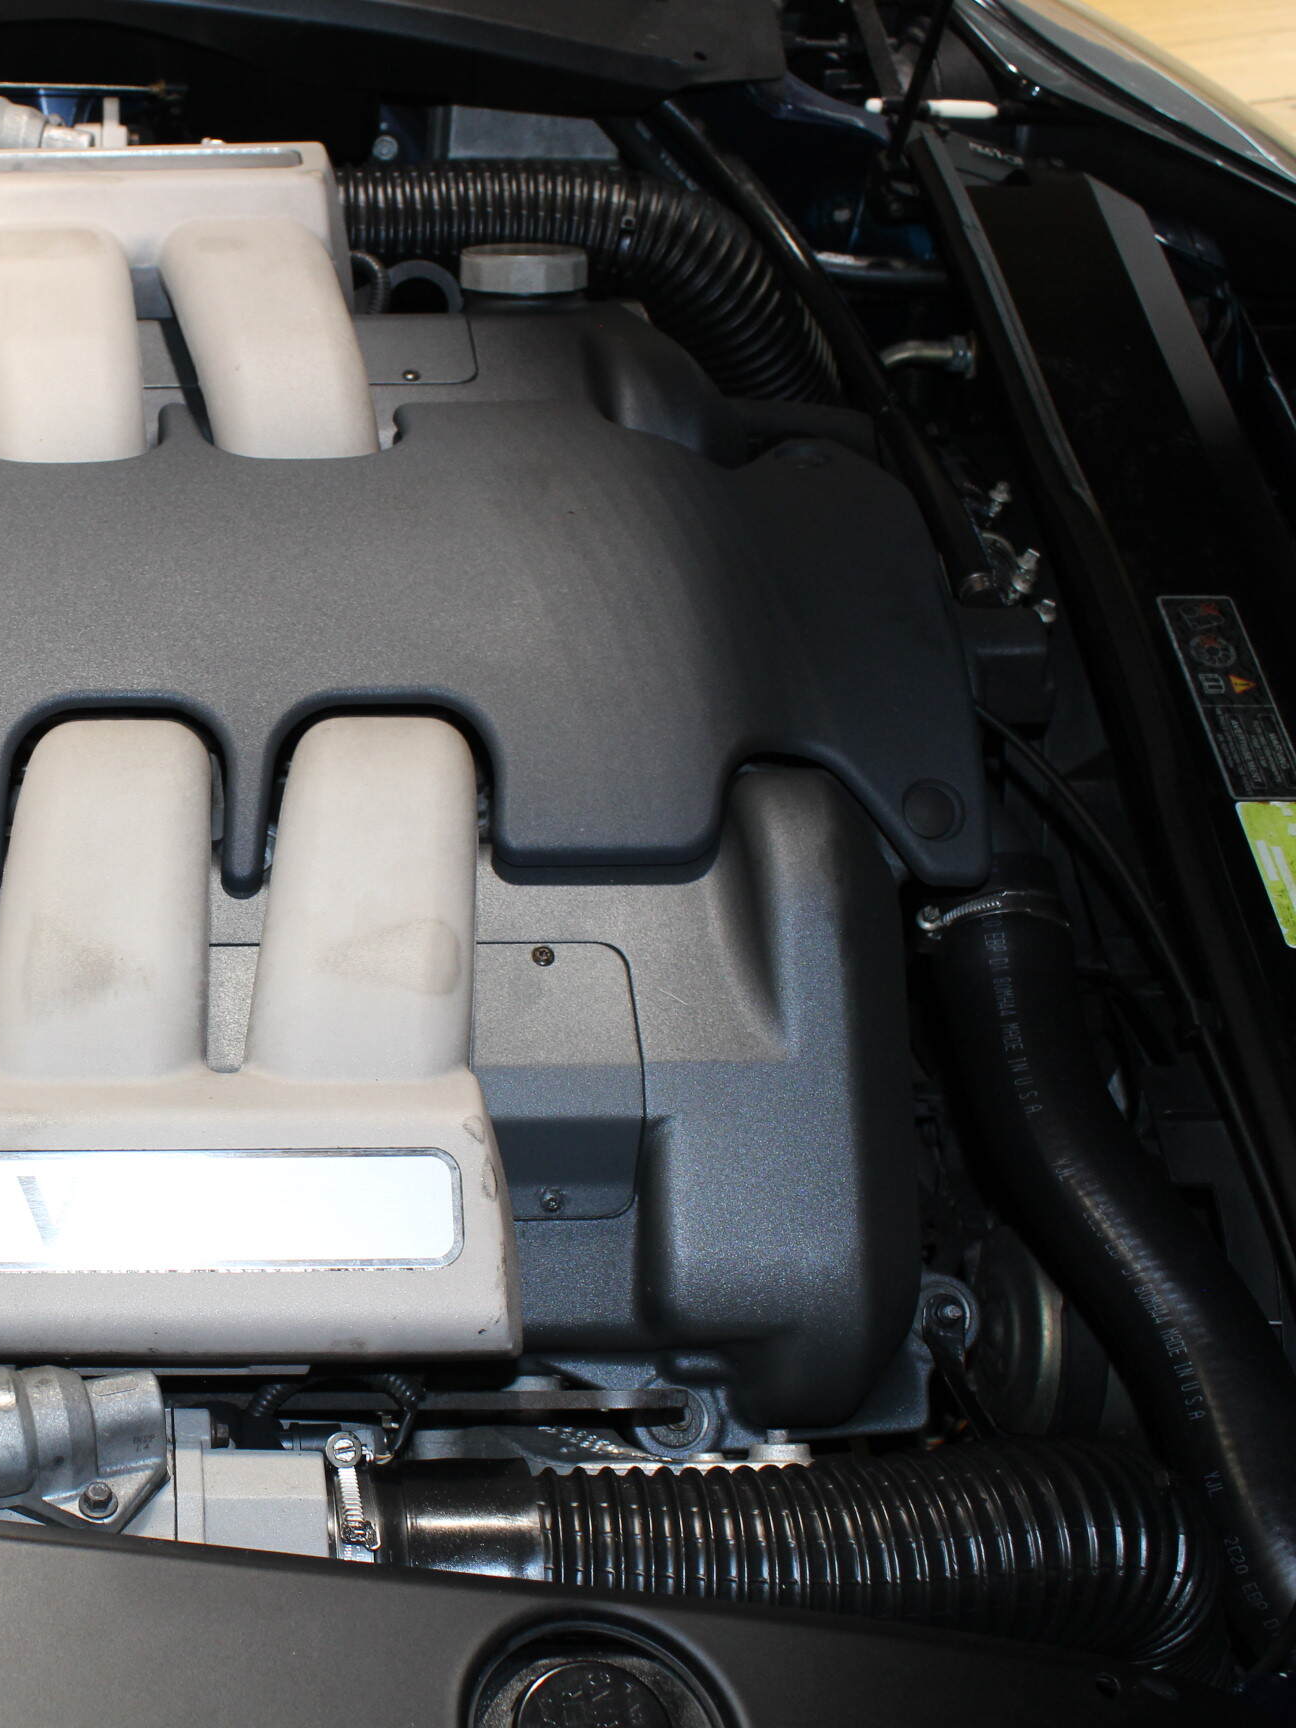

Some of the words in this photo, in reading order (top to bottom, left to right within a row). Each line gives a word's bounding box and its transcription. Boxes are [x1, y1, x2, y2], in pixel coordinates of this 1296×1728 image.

[1001, 1022, 1024, 1052] MADE
[1008, 1057, 1029, 1073] IN
[1160, 1327, 1188, 1357] MADE
[1173, 1361, 1194, 1377] IN
